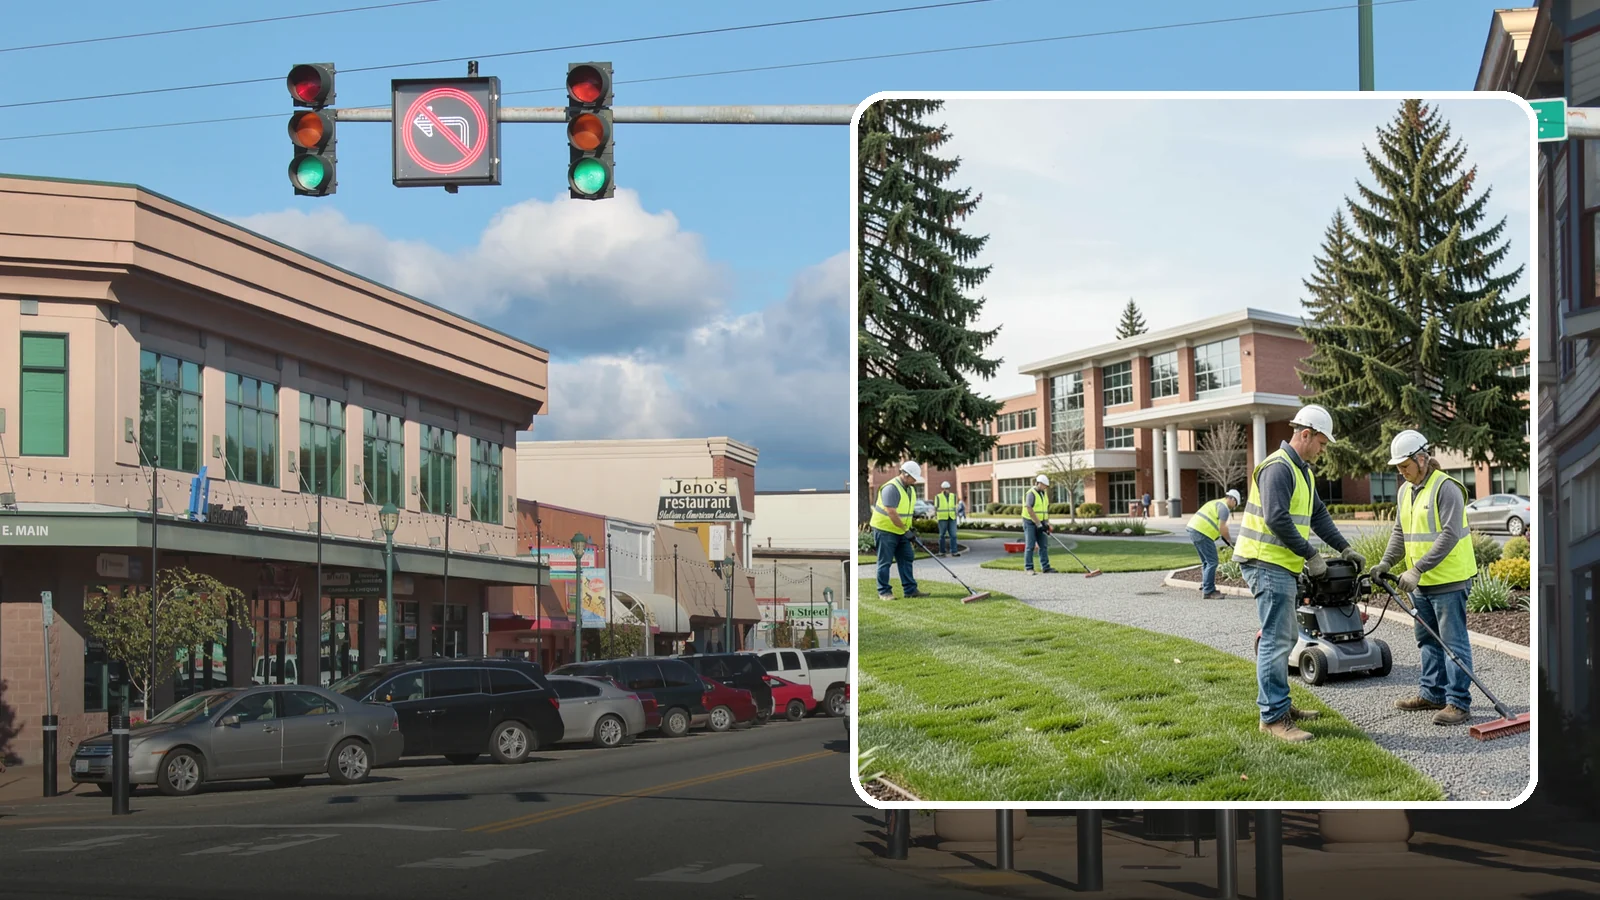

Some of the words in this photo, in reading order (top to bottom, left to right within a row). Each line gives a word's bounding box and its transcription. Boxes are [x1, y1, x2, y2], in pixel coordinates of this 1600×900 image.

[670, 480, 727, 495] Jeno's
[665, 496, 731, 509] restaurant
[686, 510, 714, 519] American
[715, 509, 737, 519] Cuisine
[2, 525, 13, 536] E.
[15, 525, 49, 536] MAIN
[786, 607, 795, 616] in
[797, 607, 828, 616] Street
